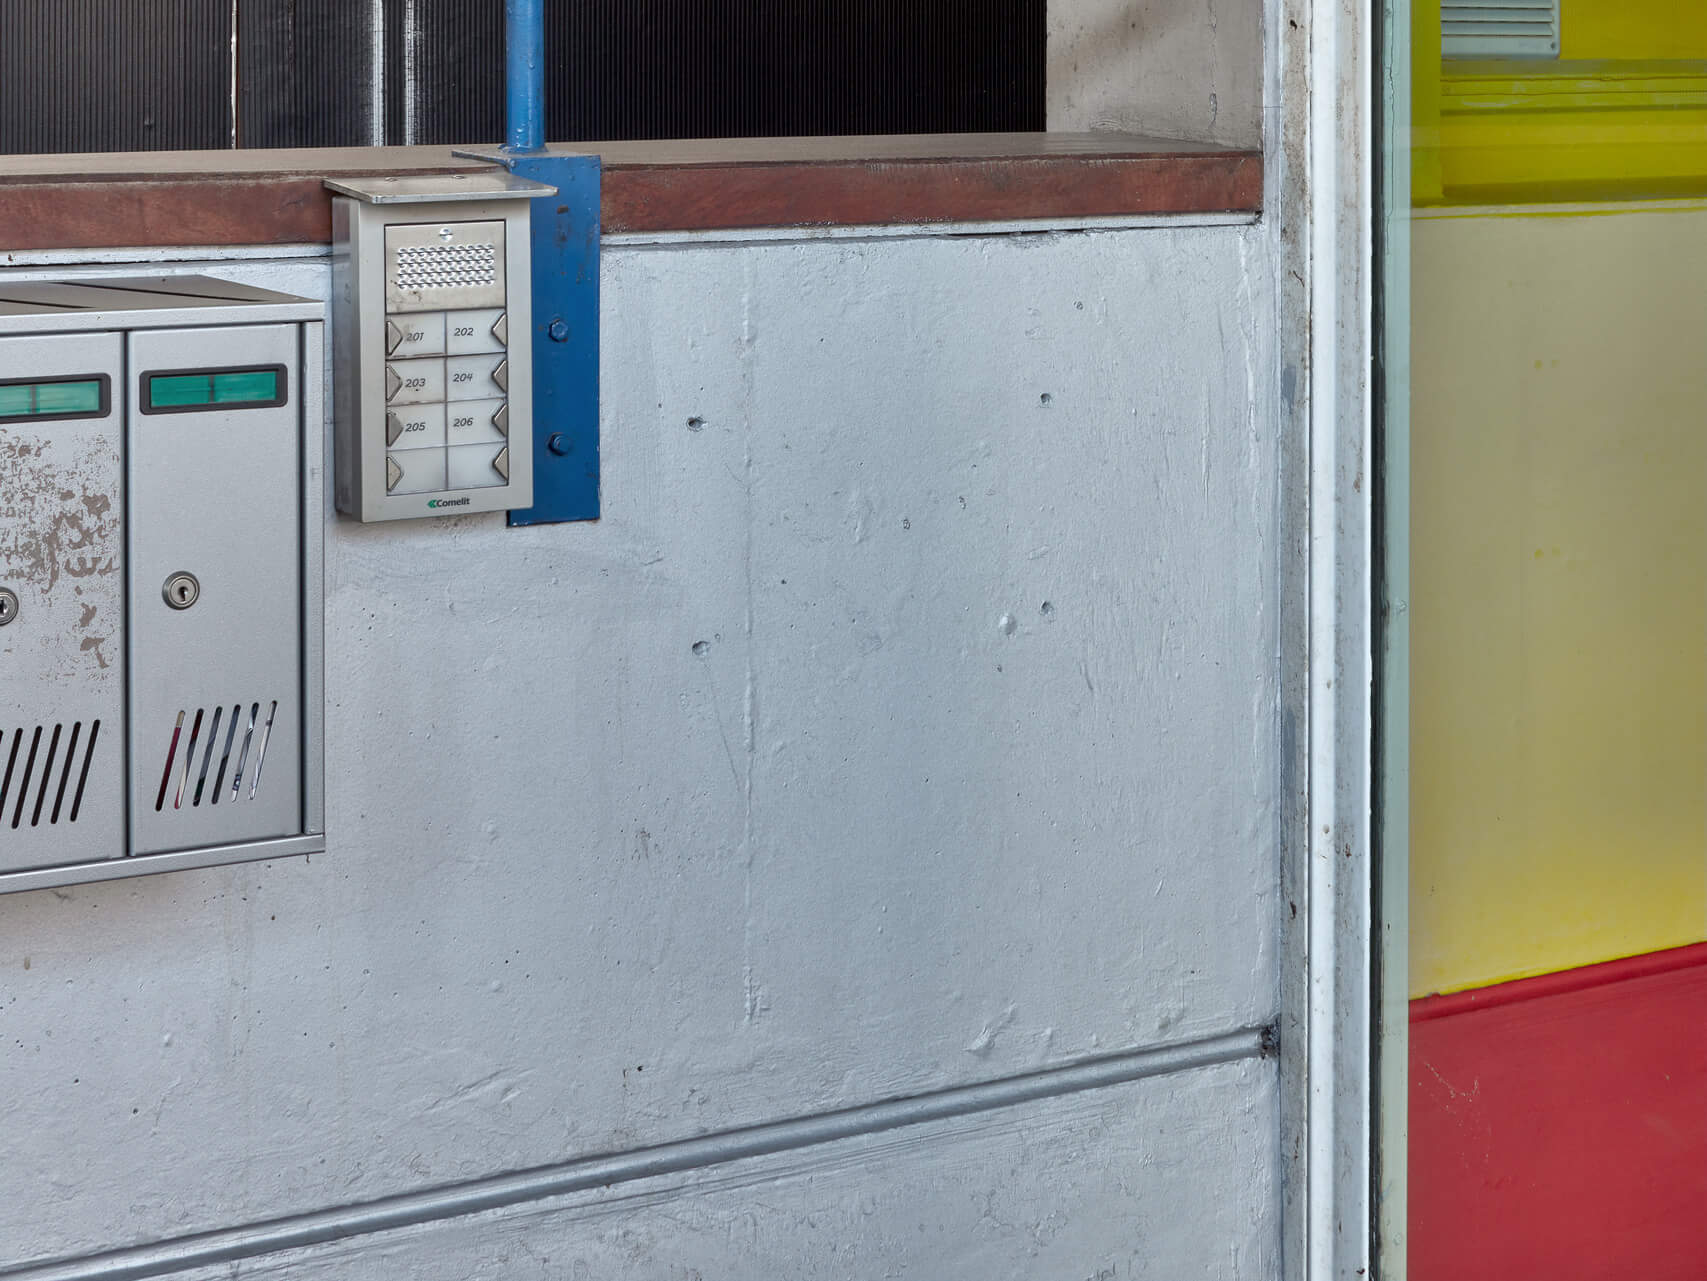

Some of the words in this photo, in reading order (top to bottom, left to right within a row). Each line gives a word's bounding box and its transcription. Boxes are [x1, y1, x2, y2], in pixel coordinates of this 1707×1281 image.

[406, 332, 425, 342] 201
[454, 327, 474, 337] 202
[405, 378, 426, 388] 203
[453, 373, 473, 383] 204
[405, 422, 426, 432] 205
[453, 417, 474, 428] 206
[436, 497, 471, 508] Comelit
